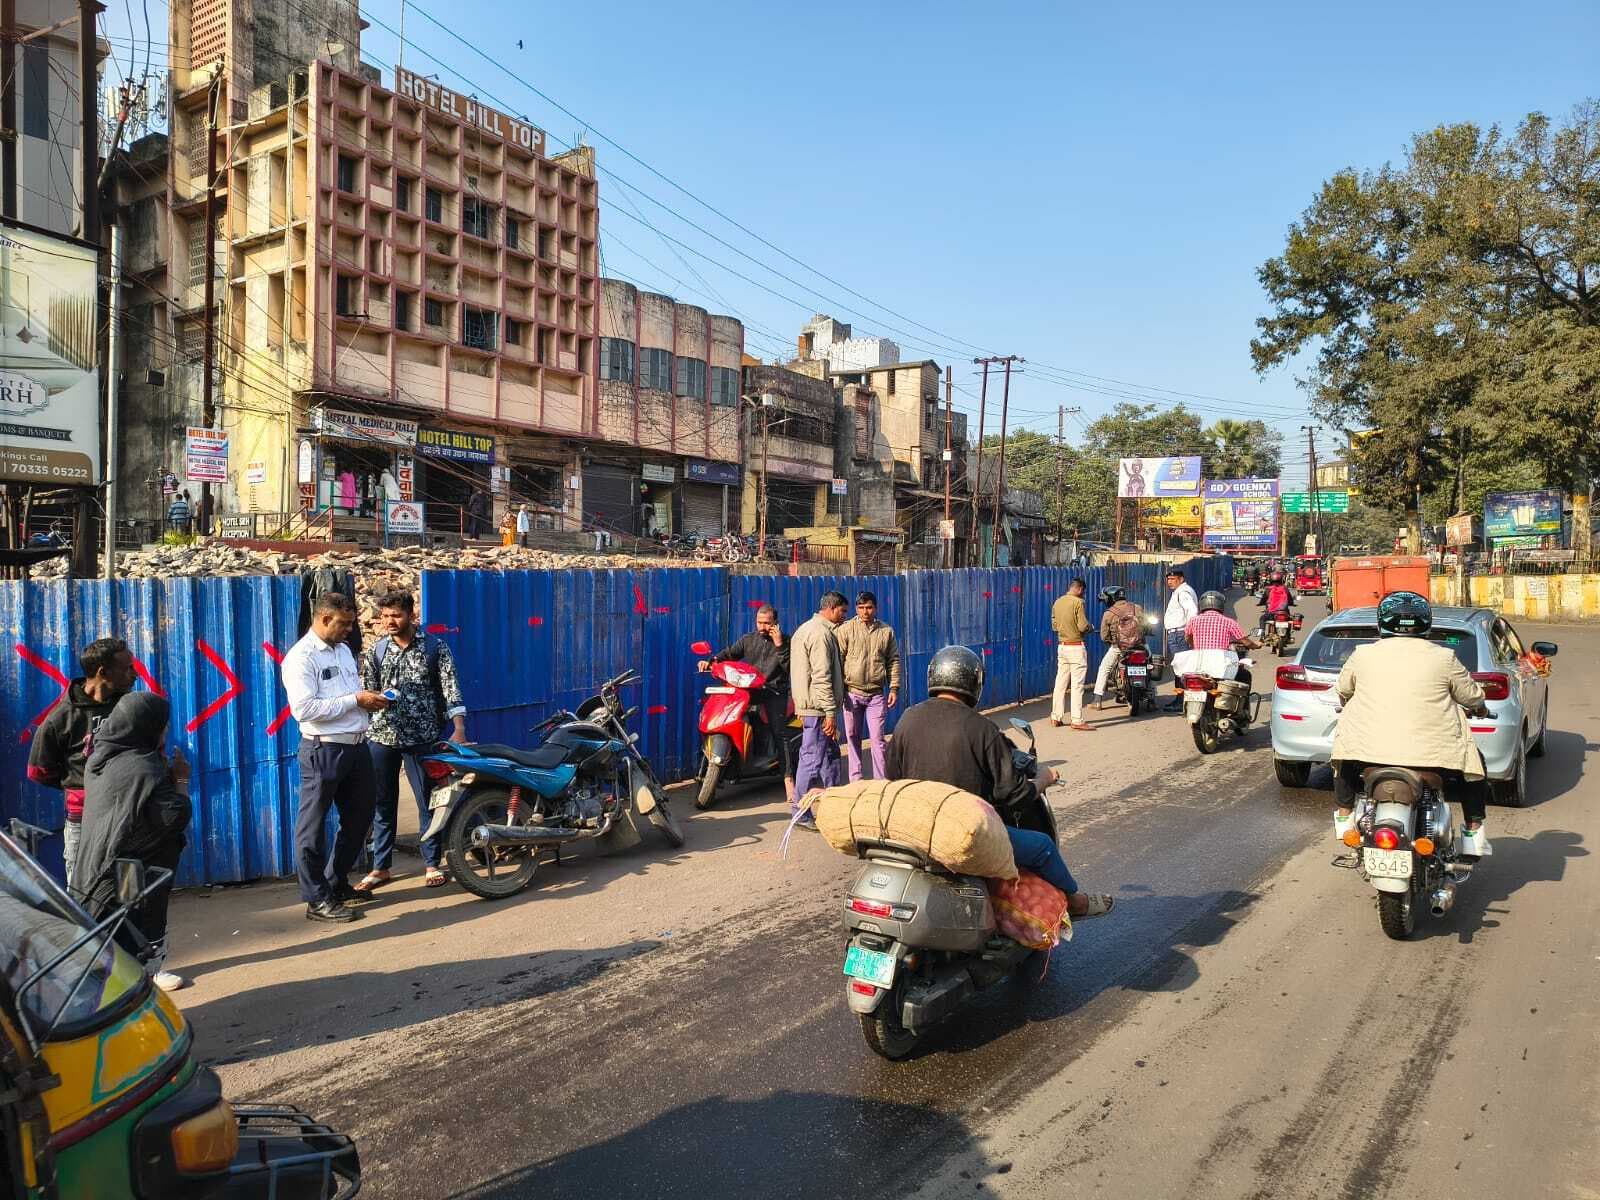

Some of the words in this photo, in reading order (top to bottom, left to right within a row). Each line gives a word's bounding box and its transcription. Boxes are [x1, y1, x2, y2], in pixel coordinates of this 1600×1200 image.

[399, 70, 462, 117] HOTEL
[465, 100, 504, 136] HILL
[508, 119, 542, 152] TOP
[359, 417, 394, 430] MEDICAL
[395, 421, 416, 433] HALL
[28, 427, 67, 439] BANQUET
[418, 429, 451, 447] HOTEL
[452, 433, 473, 450] HILL
[474, 437, 493, 453] TOP
[29, 453, 48, 463] Call
[11, 463, 49, 476] 70335
[52, 466, 89, 478] 05222
[1232, 483, 1272, 492] GOENKA
[222, 517, 239, 527] HOTEL
[222, 529, 250, 538] RECEPTION
[1368, 857, 1409, 874] 3645
